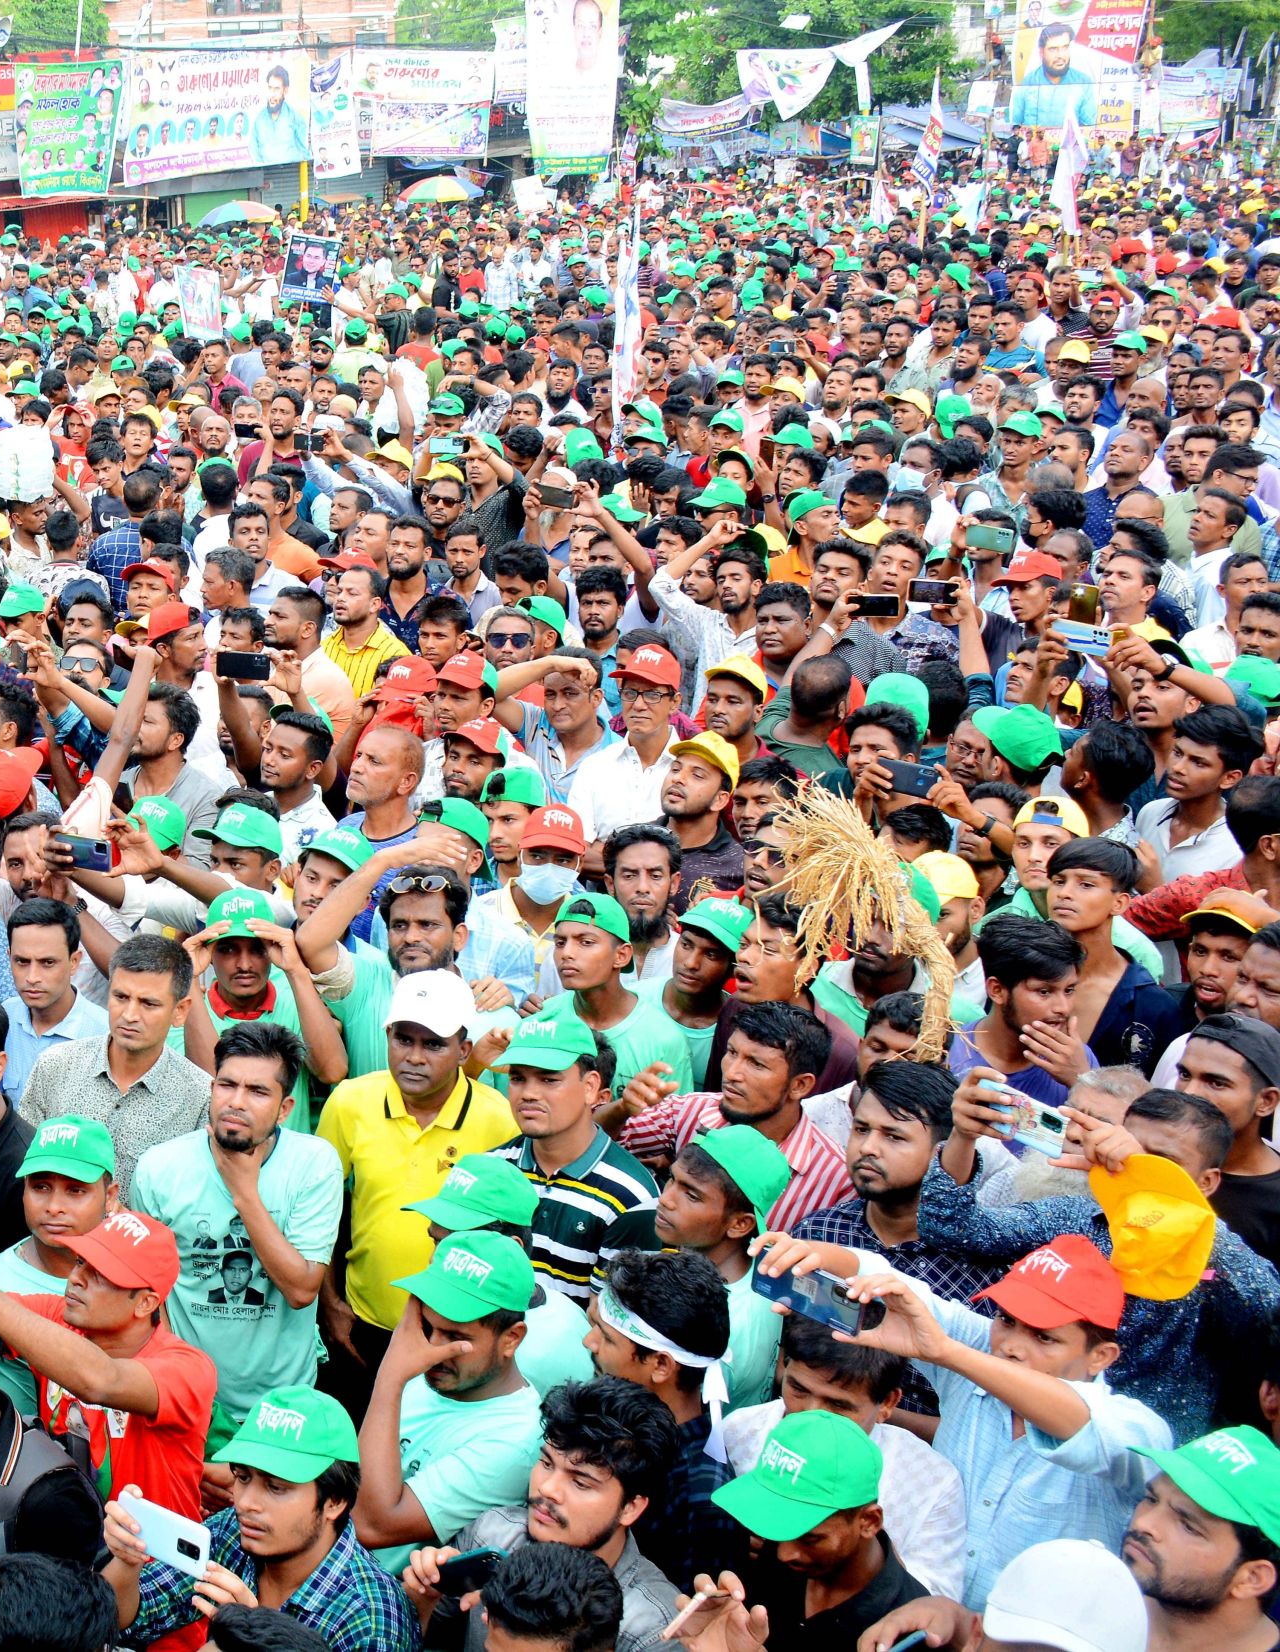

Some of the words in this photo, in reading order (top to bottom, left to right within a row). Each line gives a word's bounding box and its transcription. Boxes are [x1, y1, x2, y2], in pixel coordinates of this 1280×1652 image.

[1087, 34, 1138, 51] সমাবেশ
[177, 71, 219, 94] তারুণ্যের
[221, 68, 260, 87] সমাবেশ
[384, 67, 440, 78] তারুণ্যের
[543, 810, 573, 831] যুবদল
[39, 1123, 80, 1148] ছাত্রদল
[104, 1212, 150, 1247] যুবদল
[444, 1247, 494, 1289] ছাত্রদল
[1019, 1248, 1072, 1283] যুবদল
[191, 1301, 210, 1313] লায়ন
[212, 1305, 229, 1315] মোঃ
[232, 1306, 256, 1316] হেলাল
[256, 1401, 307, 1442] ছাত্রদল
